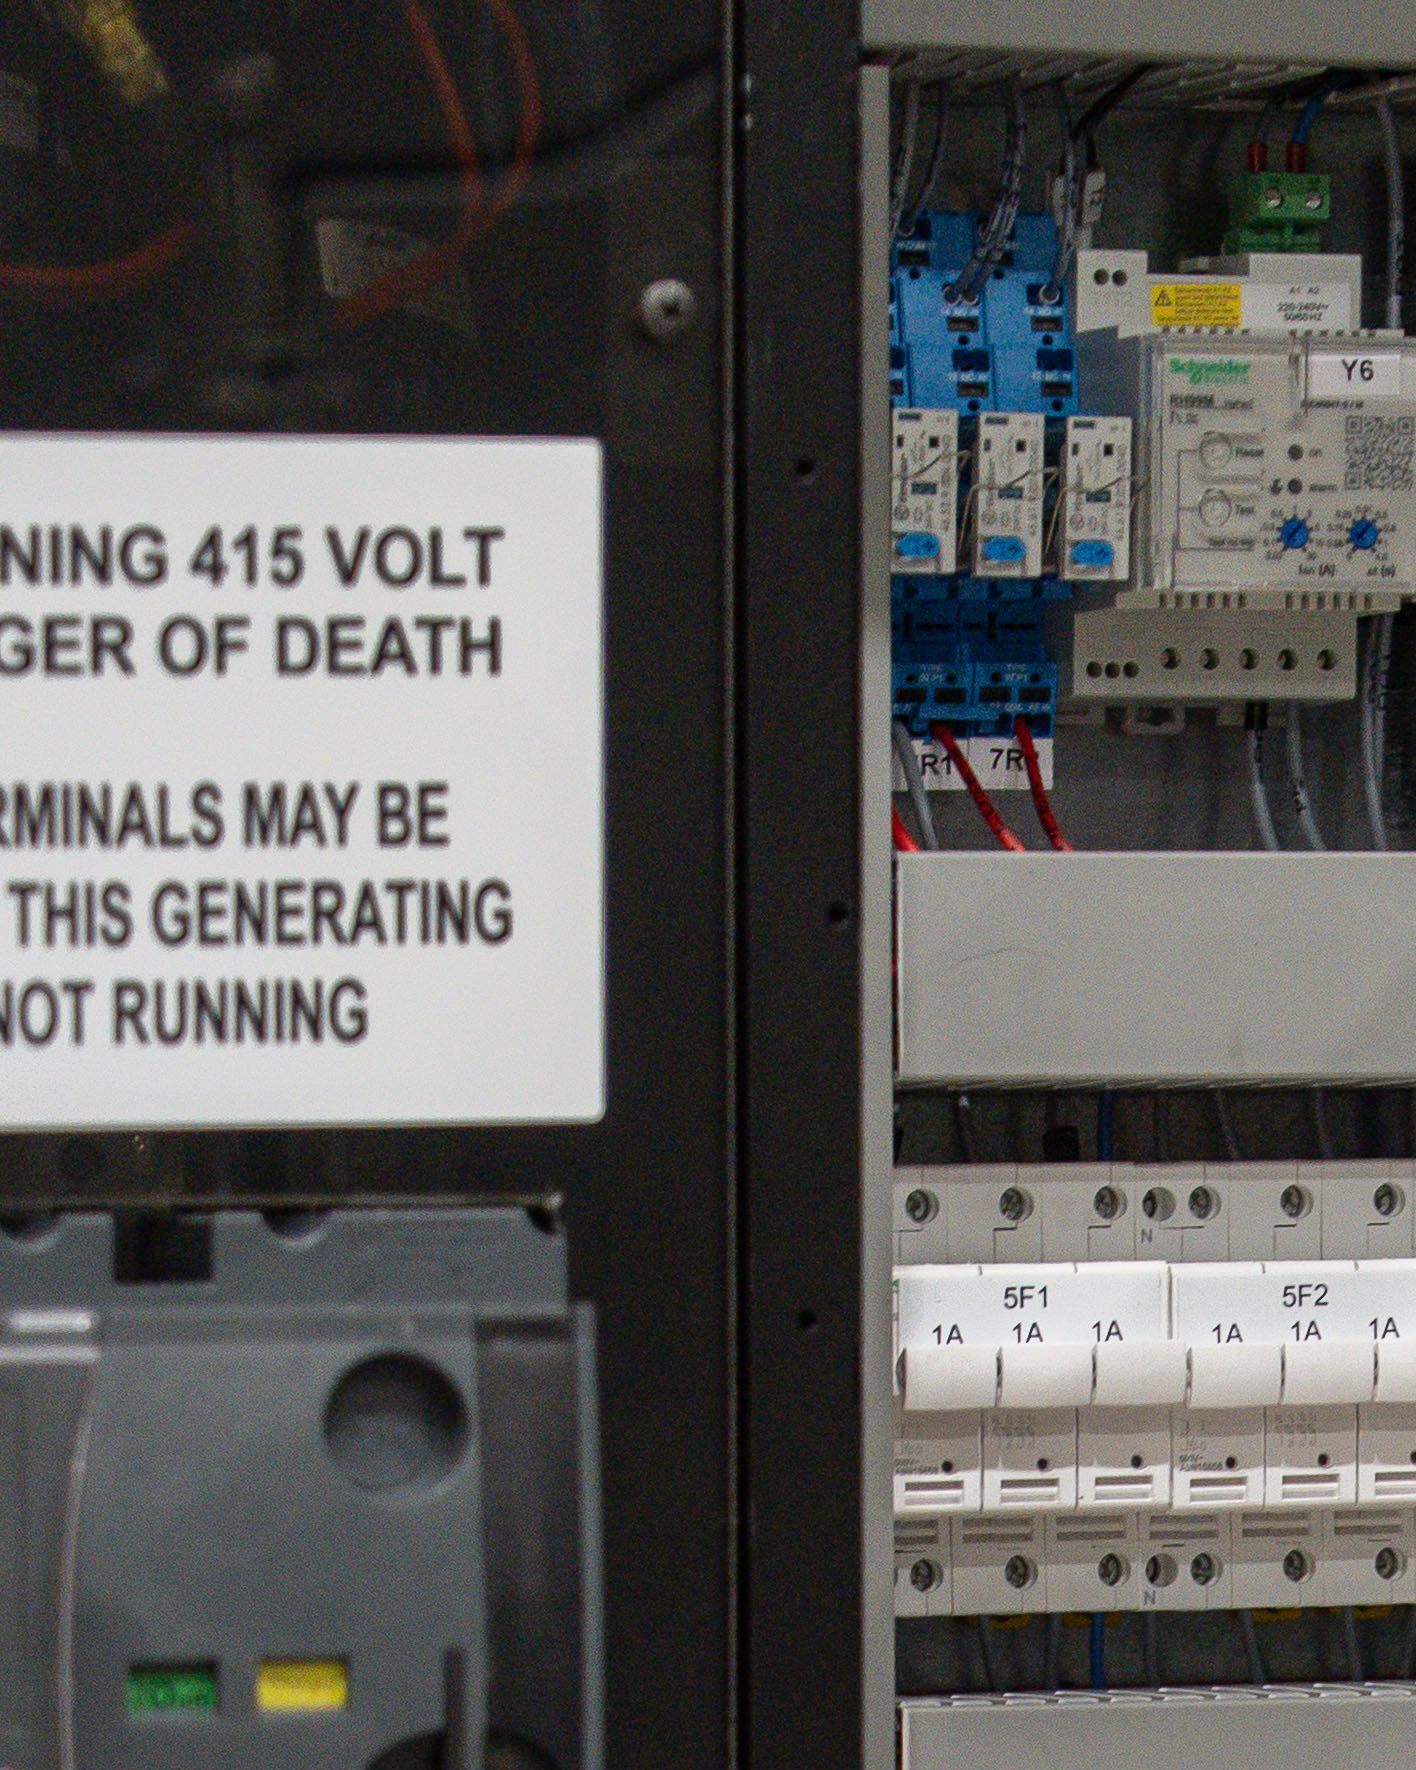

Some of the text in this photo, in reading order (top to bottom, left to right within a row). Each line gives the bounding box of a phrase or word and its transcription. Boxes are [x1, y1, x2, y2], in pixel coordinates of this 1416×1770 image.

[1342, 360, 1374, 381] Y6
[0, 526, 504, 588] NING 415 VOLT
[158, 615, 250, 677] OF
[276, 616, 501, 676] DEATH
[990, 748, 1038, 770] 7R
[244, 783, 358, 846] MAY
[378, 782, 449, 847] BE
[8, 879, 512, 948] THIS GENERATING
[114, 978, 367, 1045] RUNNING
[1004, 1286, 1047, 1309] 5F1
[1283, 1283, 1328, 1308] 5F2
[933, 1324, 963, 1344] 1A
[1013, 1322, 1043, 1342] 1A
[1093, 1320, 1123, 1342] 1A
[1213, 1323, 1243, 1343] 1A
[1292, 1320, 1321, 1341] 1A
[1369, 1317, 1399, 1339] 1A
